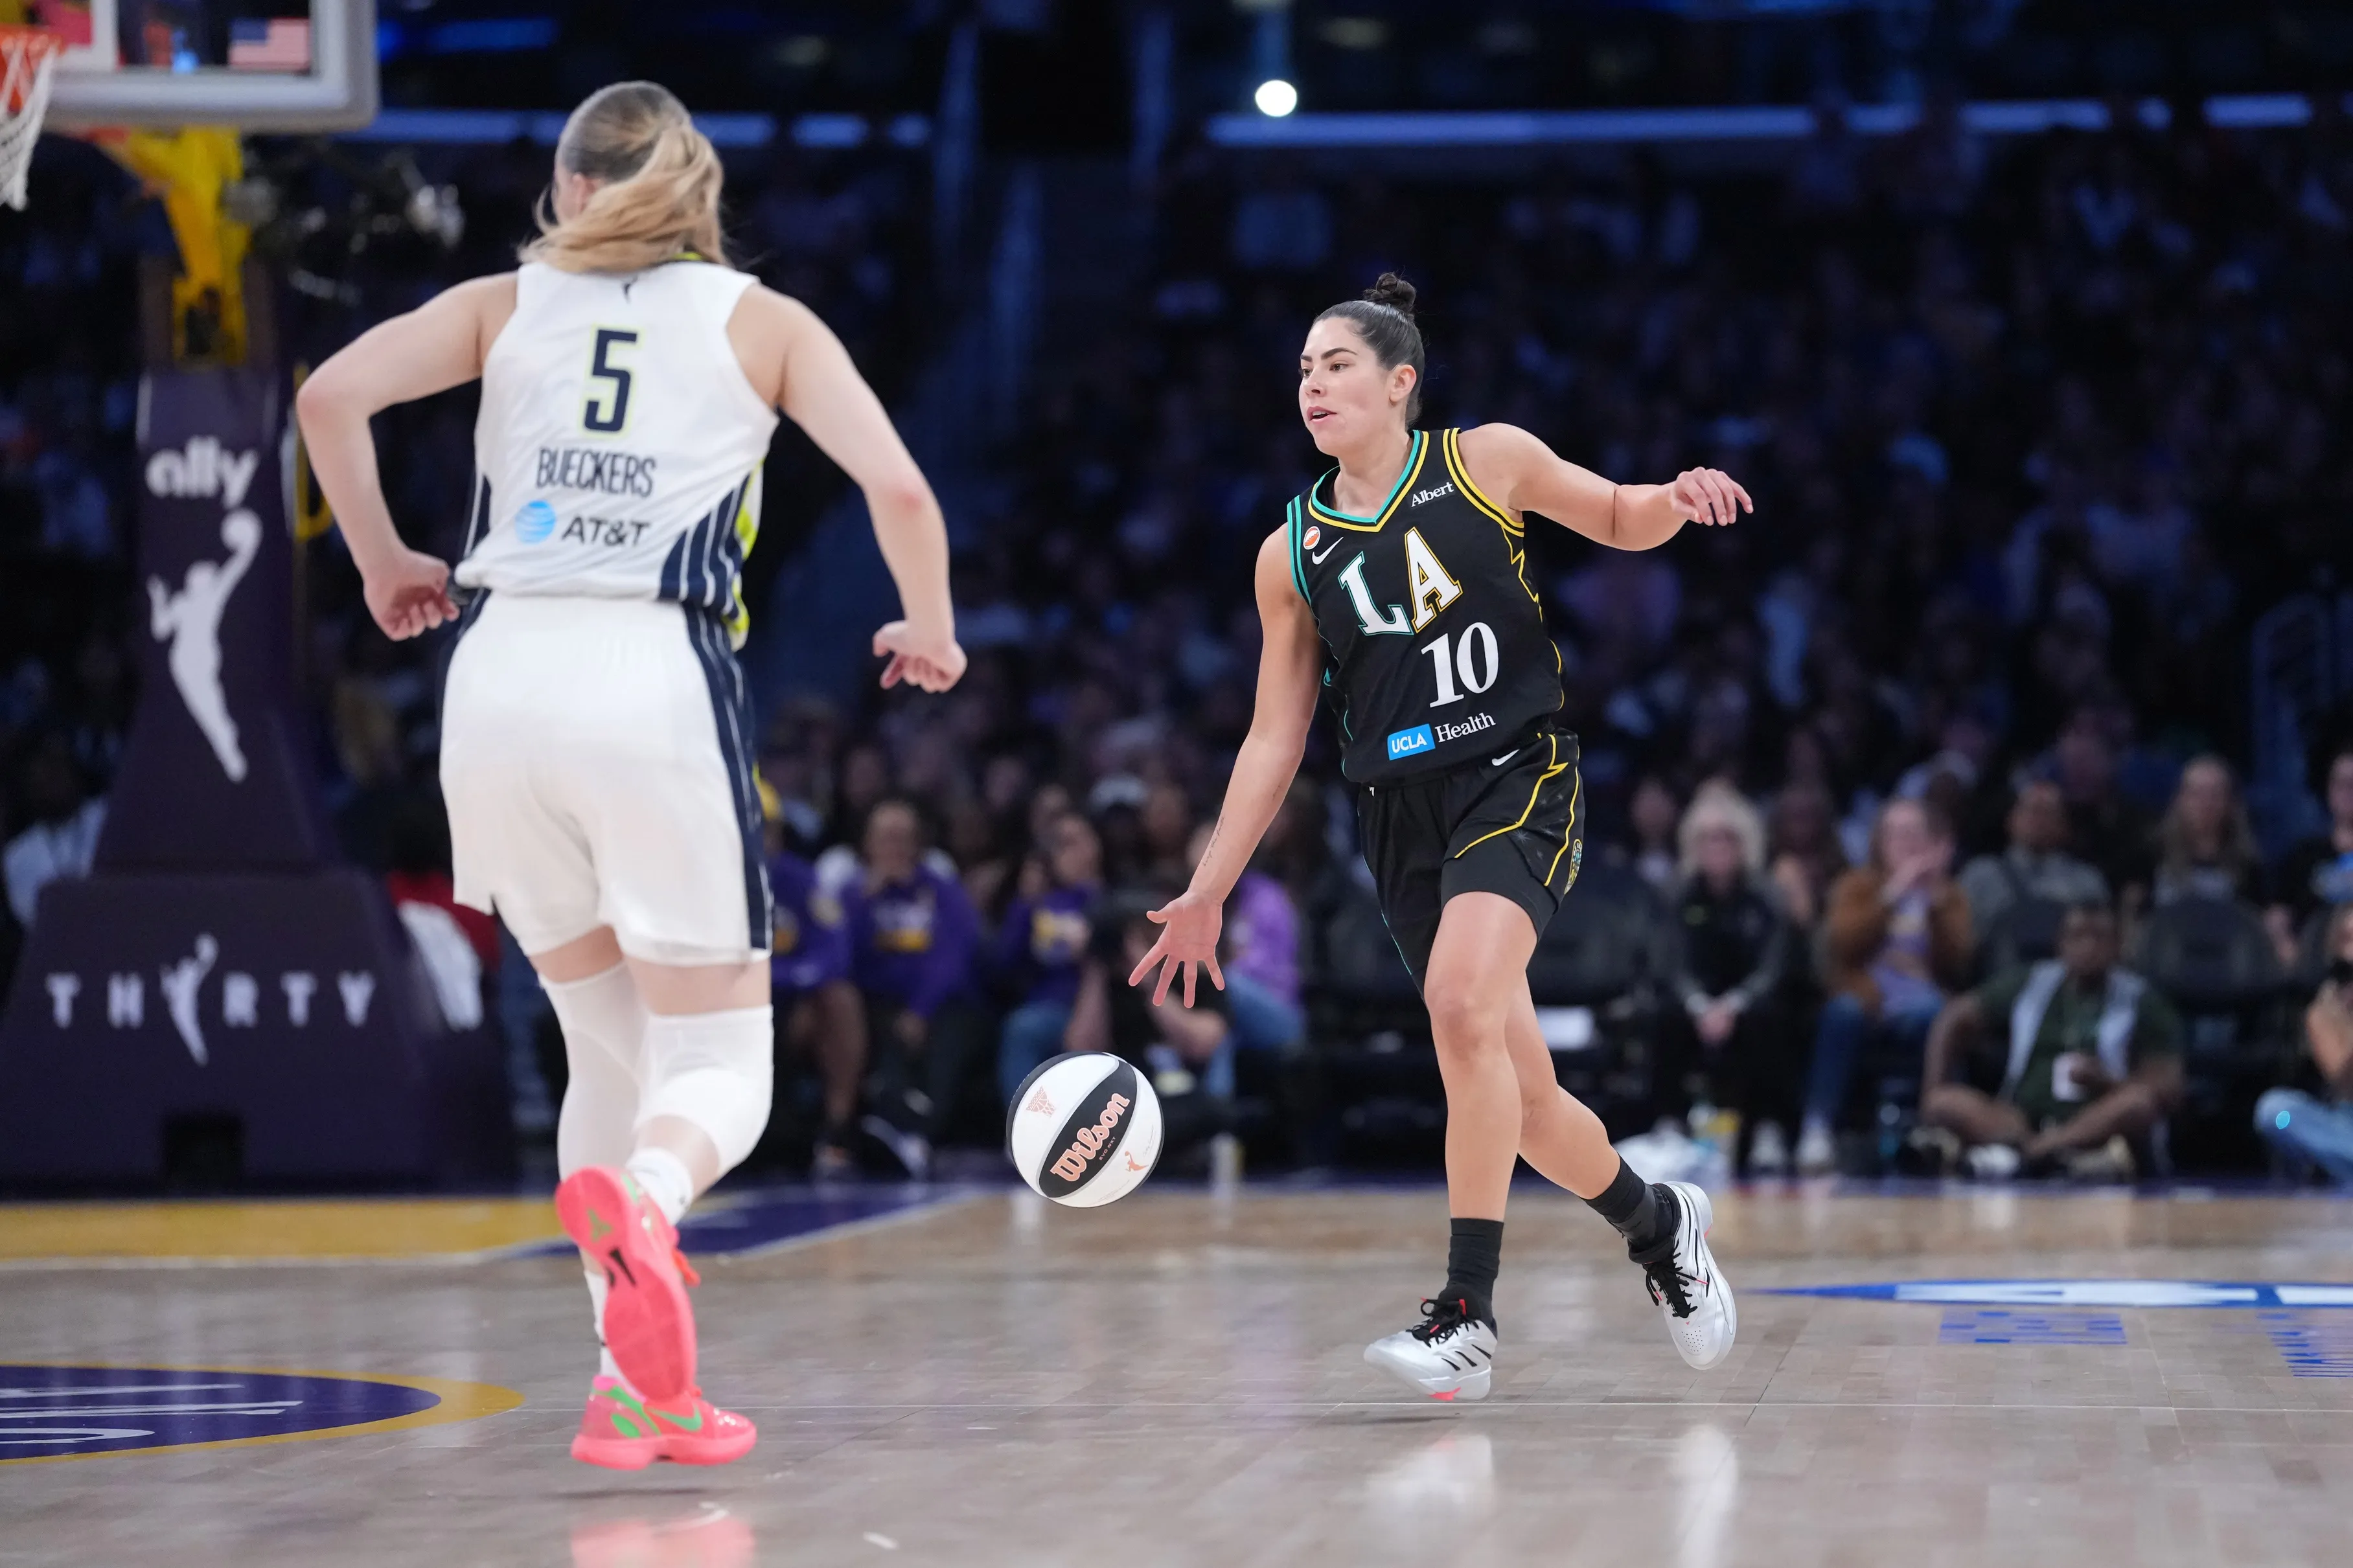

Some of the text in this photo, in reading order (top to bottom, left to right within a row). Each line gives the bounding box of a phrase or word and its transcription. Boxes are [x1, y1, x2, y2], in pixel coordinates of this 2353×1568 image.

[582, 326, 639, 435] 5
[146, 435, 259, 508] ally
[536, 446, 657, 497] BUECKERS
[1411, 481, 1454, 507] Albert
[561, 517, 650, 547] AT&T
[1338, 527, 1463, 635] LA
[1421, 622, 1498, 707] 10
[1391, 712, 1496, 753] UCLA Health
[1050, 1093, 1131, 1182] Wilson
[1099, 1136, 1116, 1161] EVO NXT
